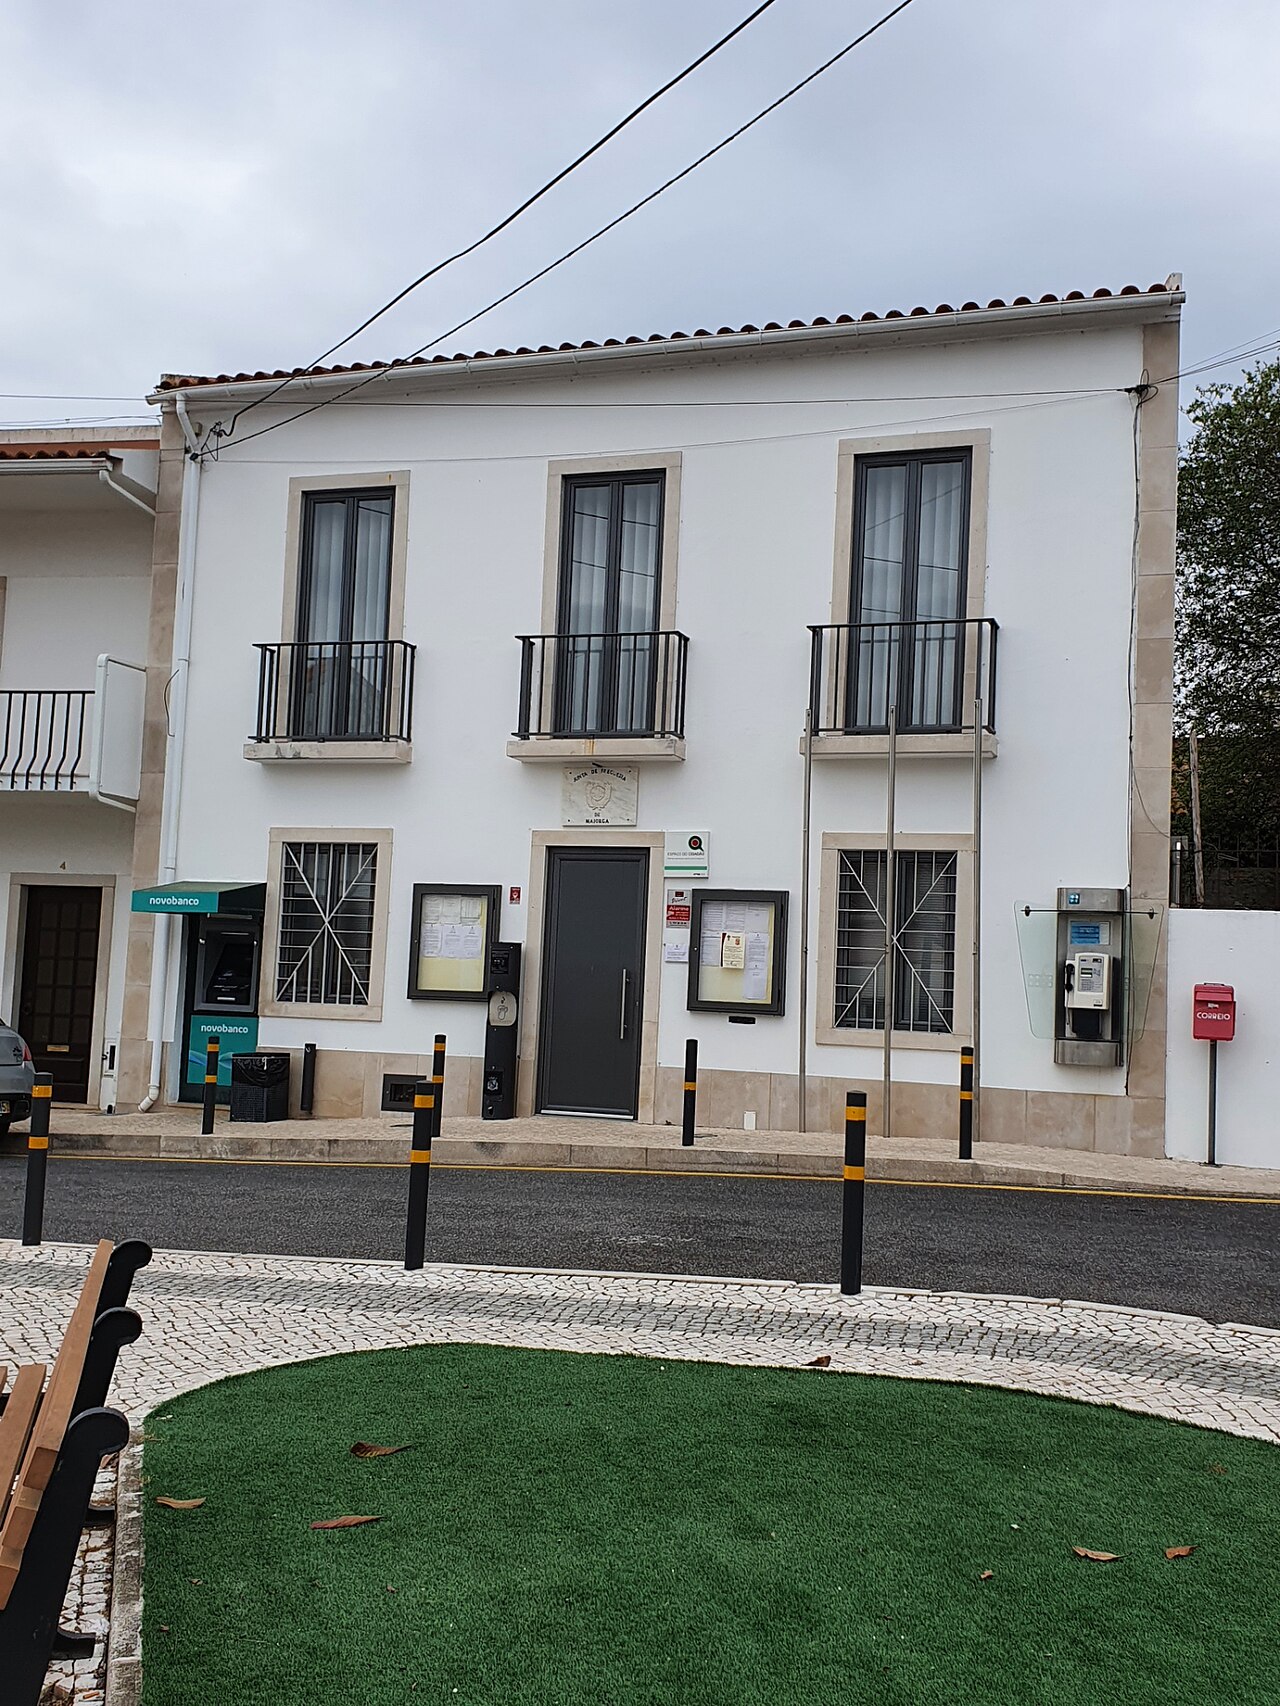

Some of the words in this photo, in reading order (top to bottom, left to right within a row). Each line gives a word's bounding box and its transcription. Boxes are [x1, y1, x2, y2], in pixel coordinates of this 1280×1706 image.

[59, 861, 66, 870] 4
[149, 895, 200, 906] novobanco
[1196, 1011, 1231, 1020] CORREIO
[201, 1023, 249, 1034] novobanco
